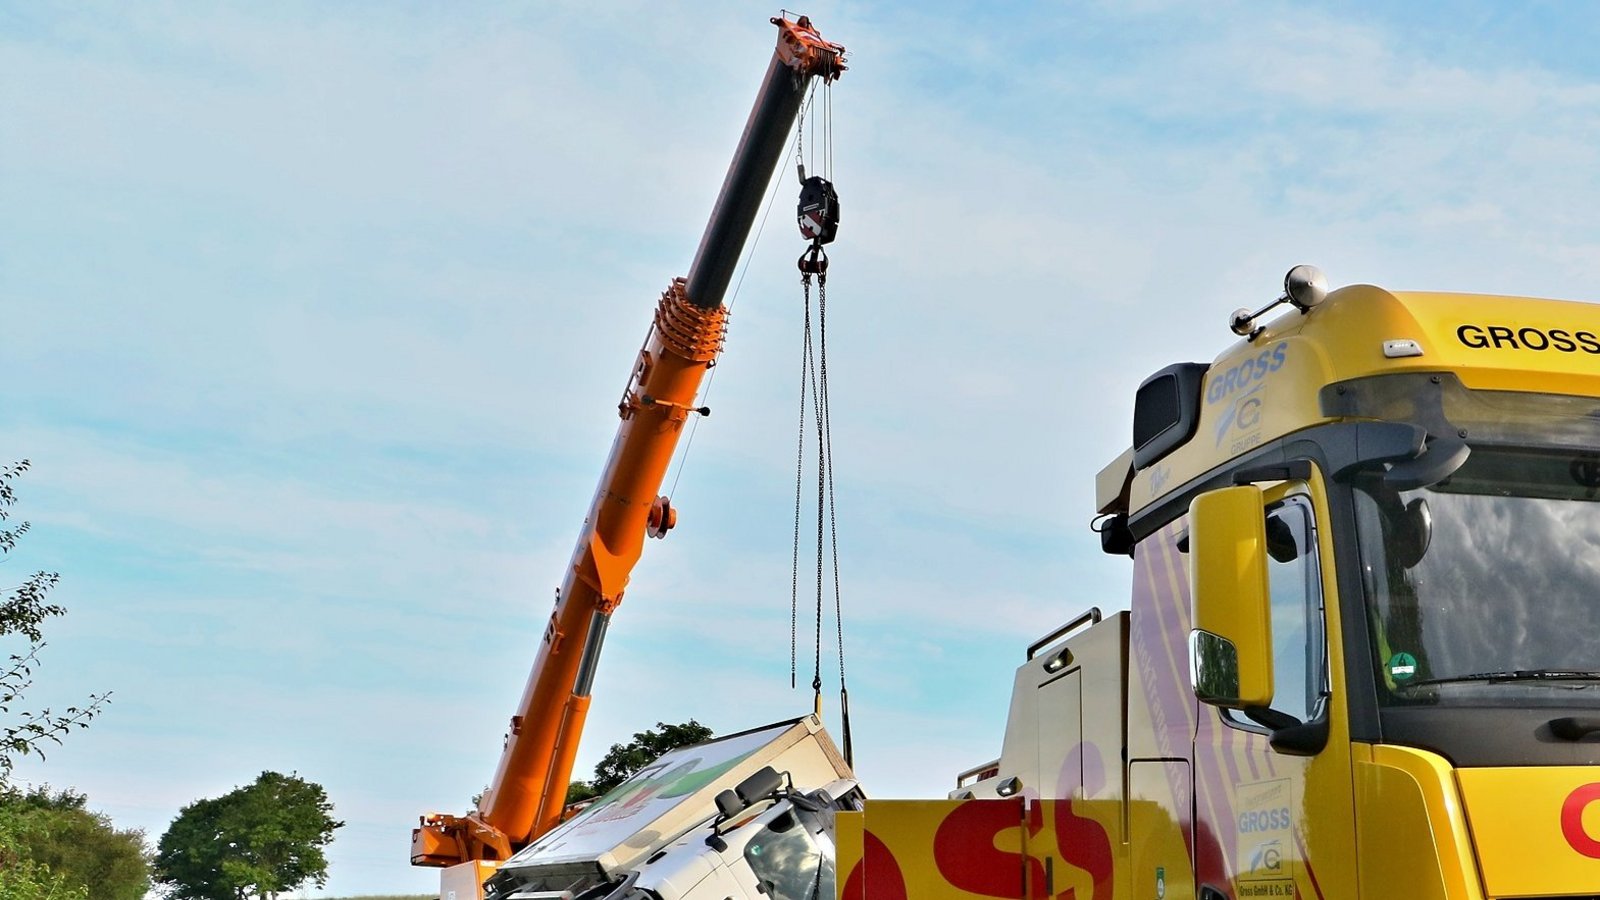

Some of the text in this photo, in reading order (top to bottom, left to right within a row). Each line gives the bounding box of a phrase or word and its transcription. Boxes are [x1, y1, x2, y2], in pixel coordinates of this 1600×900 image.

[1456, 324, 1600, 355] GROSS
[1207, 341, 1288, 405] GROSS
[1231, 433, 1262, 455] GRUPPE
[1239, 807, 1290, 833] GROSS
